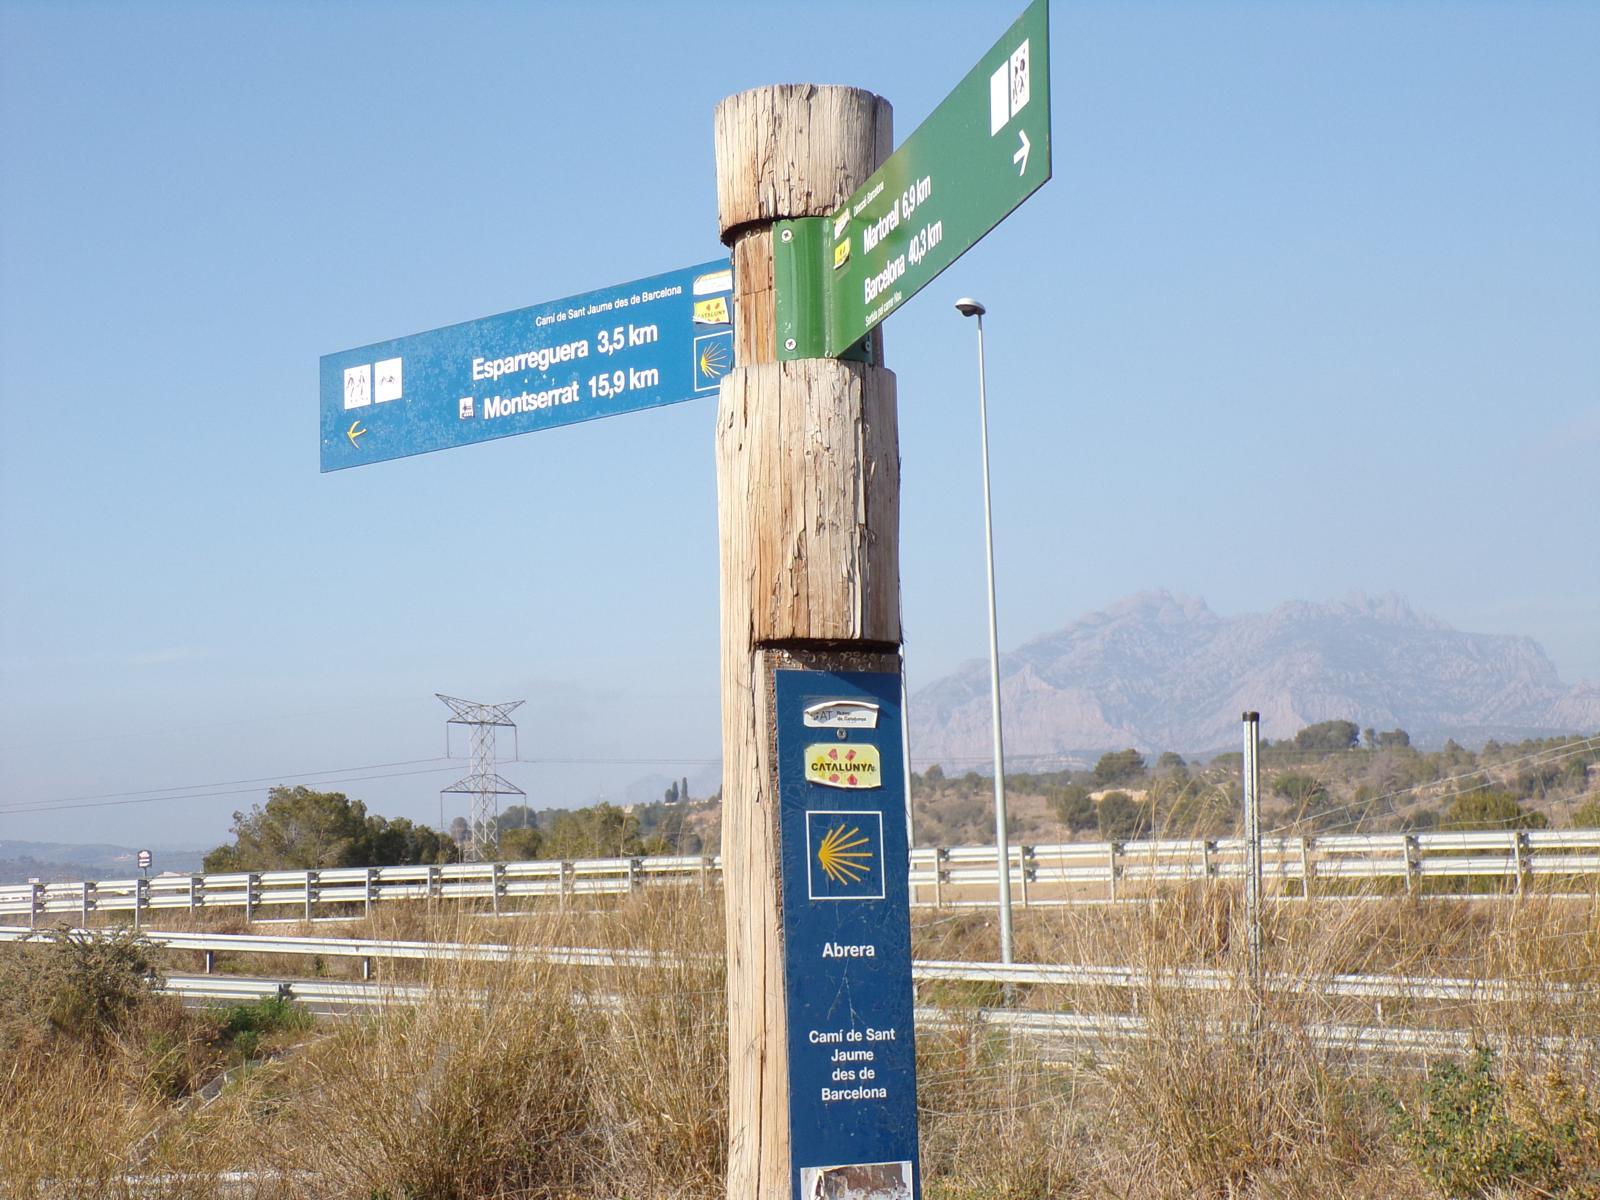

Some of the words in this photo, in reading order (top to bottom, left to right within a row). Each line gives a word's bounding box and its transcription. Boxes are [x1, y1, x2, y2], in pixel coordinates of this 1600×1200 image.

[863, 199, 900, 255] Martorell
[902, 184, 916, 220] 6,9
[917, 175, 931, 206] km
[864, 254, 905, 304] Barcelona
[908, 228, 926, 265] 40,3
[927, 220, 942, 250] km
[557, 312, 567, 322] de
[568, 306, 585, 319] Sant
[587, 301, 612, 315] Jaume
[614, 298, 629, 309] des
[630, 294, 640, 305] de
[642, 285, 682, 302] Barcelona
[472, 339, 589, 382] Esparreguera
[597, 326, 625, 356] 3,5
[628, 323, 658, 347] km
[484, 380, 580, 420] Montserrat
[588, 370, 625, 399] 15,9
[629, 367, 659, 390] km
[811, 762, 873, 772] CATALUNYA
[822, 942, 875, 958] Abrera
[809, 1029, 843, 1044] Camí
[846, 1029, 862, 1042] de
[866, 1027, 896, 1041] Sant
[831, 1049, 874, 1062] Jaume
[831, 1067, 856, 1081] des
[858, 1066, 875, 1080] de
[821, 1087, 887, 1101] Barcelona
